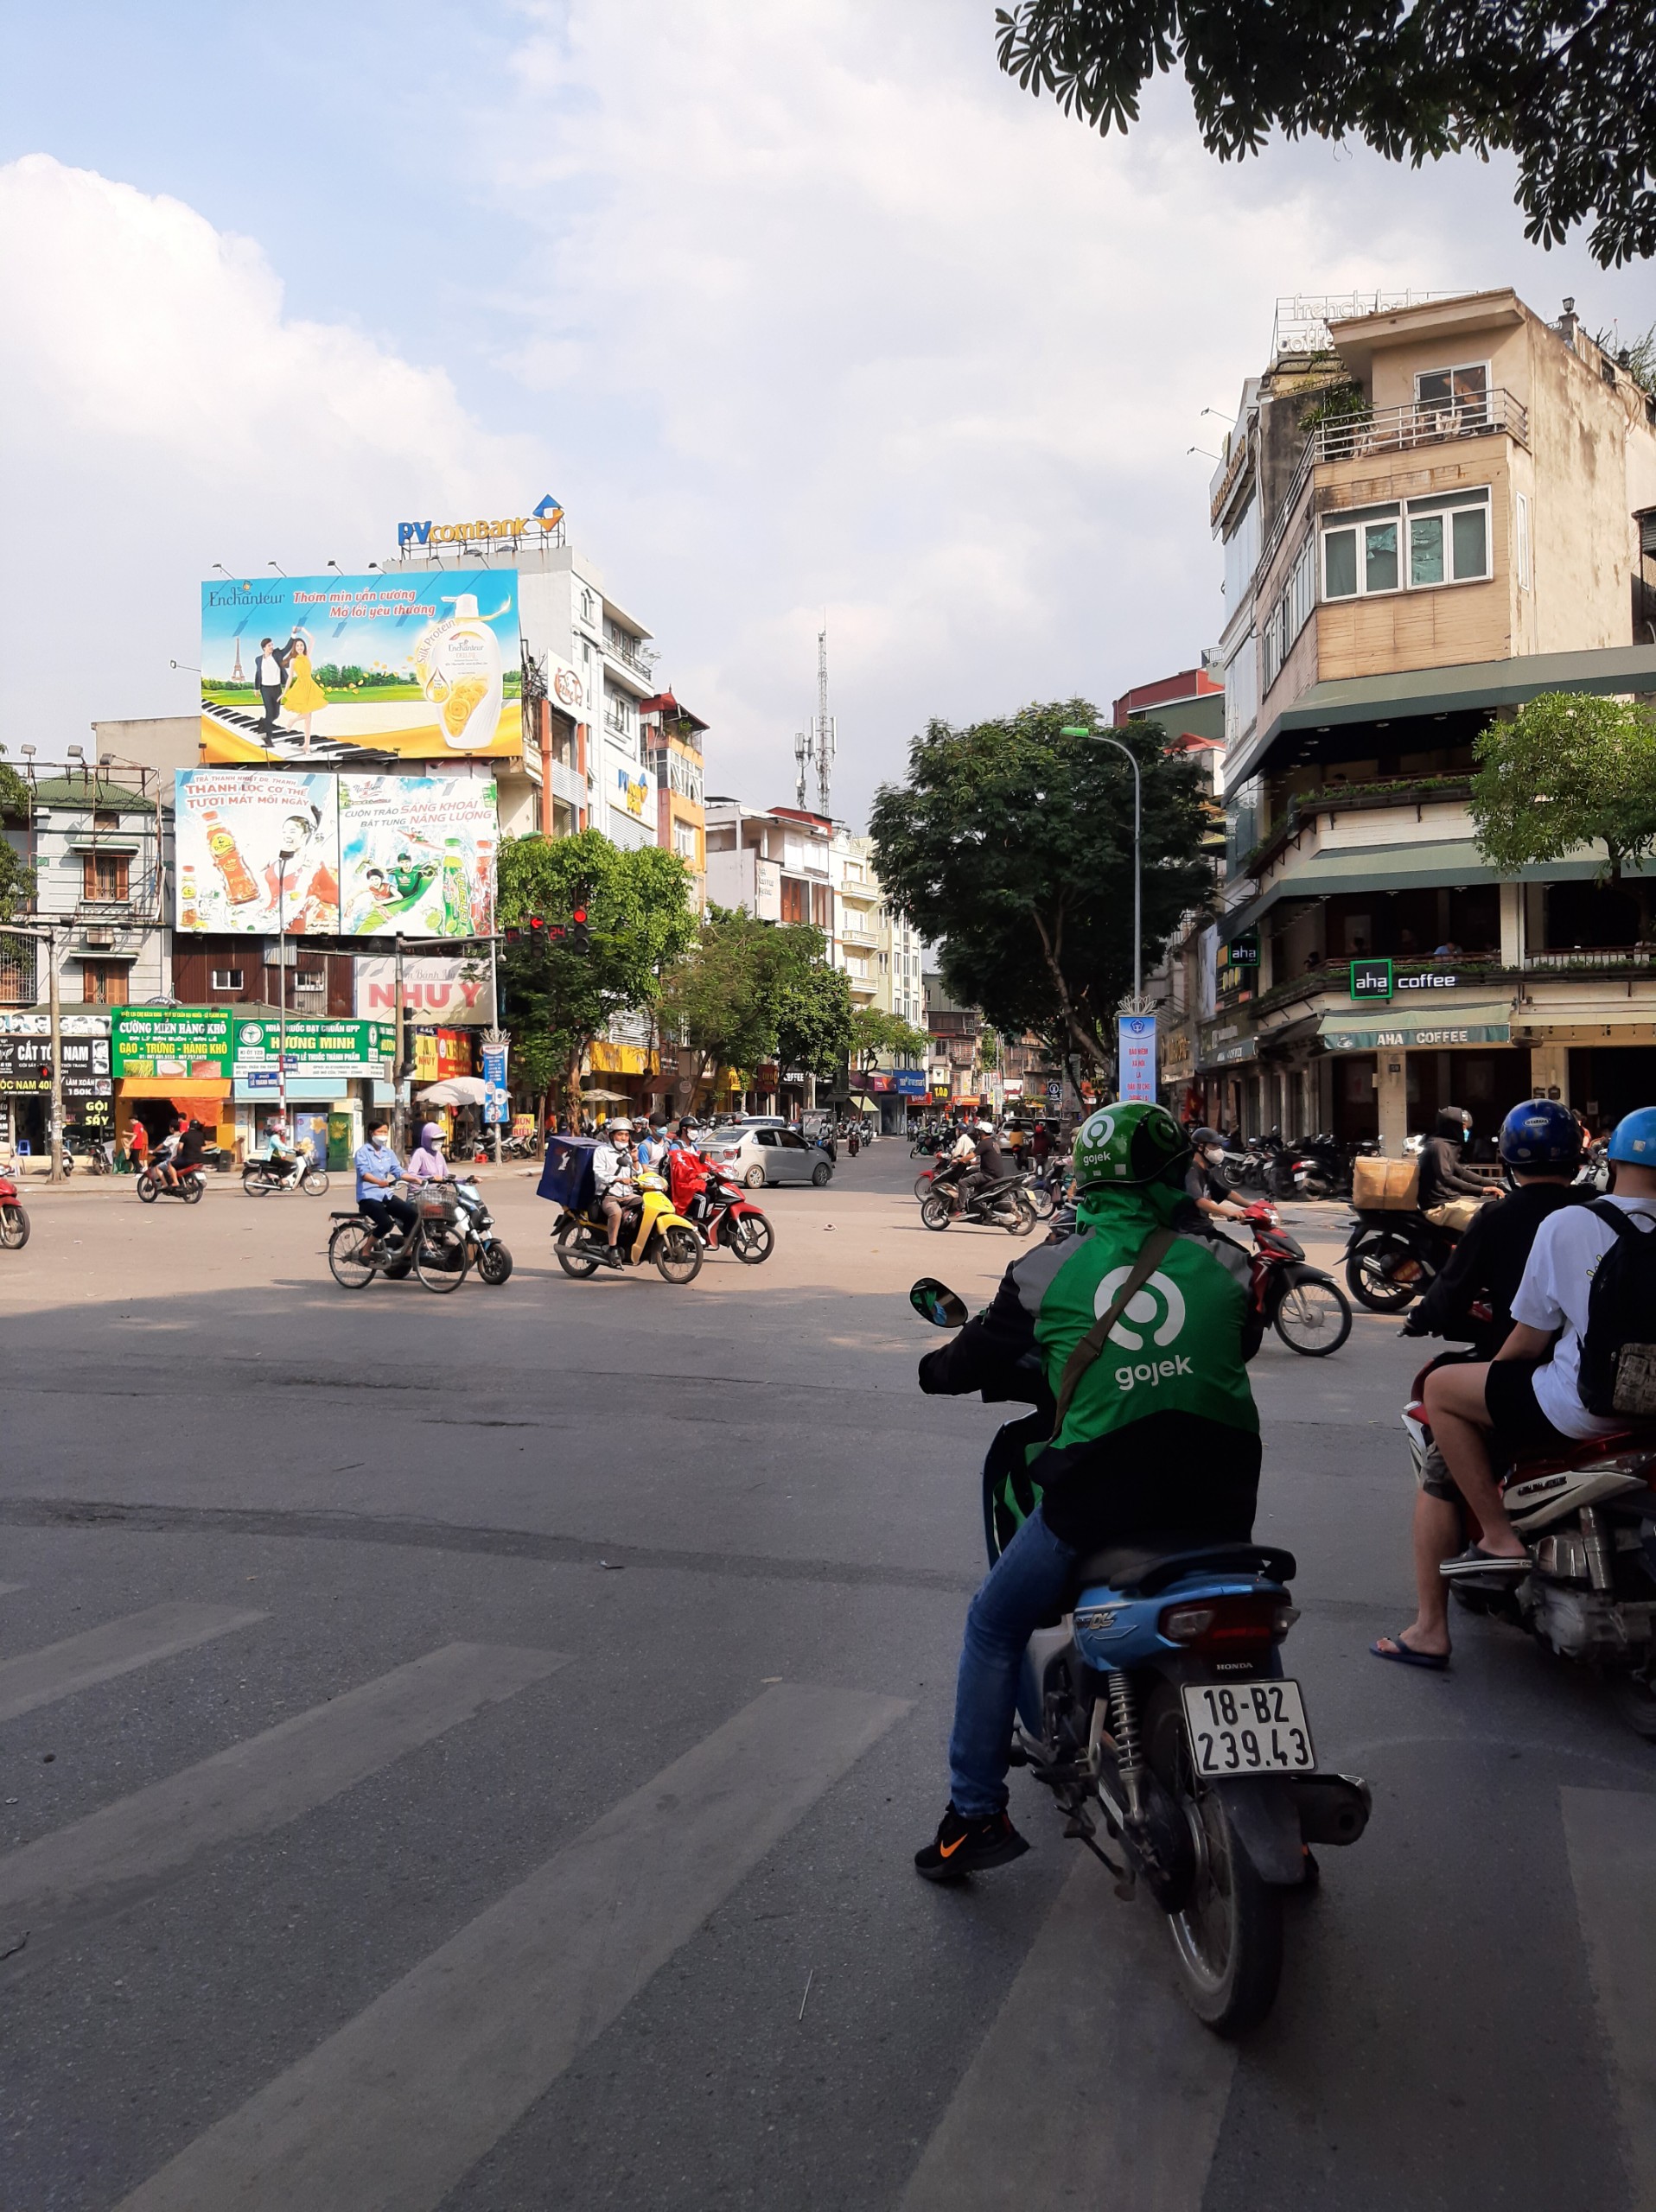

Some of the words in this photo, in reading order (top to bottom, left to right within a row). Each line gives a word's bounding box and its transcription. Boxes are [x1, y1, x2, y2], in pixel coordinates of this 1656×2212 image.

[1293, 290, 1366, 321] french
[1277, 323, 1335, 353] coffe
[398, 517, 530, 546] PVcomBank
[209, 586, 285, 607] Enchanteur
[294, 592, 326, 603] Thơm
[329, 590, 353, 604] mịn
[379, 590, 416, 602] vương
[369, 605, 391, 619] yêu
[393, 603, 436, 616] thương
[417, 645, 430, 664] Silk
[424, 619, 455, 646] Protein
[186, 784, 238, 795] THANH
[241, 784, 264, 793] LỌC
[187, 797, 225, 809] TƯƠI
[228, 793, 254, 805] MÁT
[281, 796, 309, 807] NGÀY
[455, 872, 469, 923] chanh
[550, 926, 566, 940] 24
[1232, 945, 1256, 958] aha
[1355, 971, 1388, 988] aha
[1398, 973, 1455, 988] coffee
[369, 983, 452, 1008] NHƯ
[119, 1020, 152, 1034] CƯỜNG
[178, 1020, 205, 1034] HÀNG
[207, 1020, 227, 1034] KHÔ
[286, 1022, 305, 1033] HUỐC
[320, 1036, 356, 1049] MINH
[1377, 1033, 1404, 1046] AHA
[1416, 1030, 1468, 1044] COFFEE
[17, 1039, 39, 1061] CẮT
[40, 1042, 52, 1061] TÓ
[63, 1046, 89, 1061] NAM
[119, 1042, 138, 1055] GẠO
[145, 1040, 175, 1054] TRỨNG
[182, 1040, 207, 1054] HÀNG
[209, 1040, 227, 1054] KHÔ
[16, 1080, 37, 1090] NAM
[86, 1099, 108, 1114] GỘI
[85, 1113, 110, 1126] SẤY
[1083, 1150, 1111, 1166] gojek
[1114, 1354, 1194, 1391] gojek
[1203, 1686, 1290, 1726] 18-B2
[1198, 1728, 1309, 1770] 239.43
